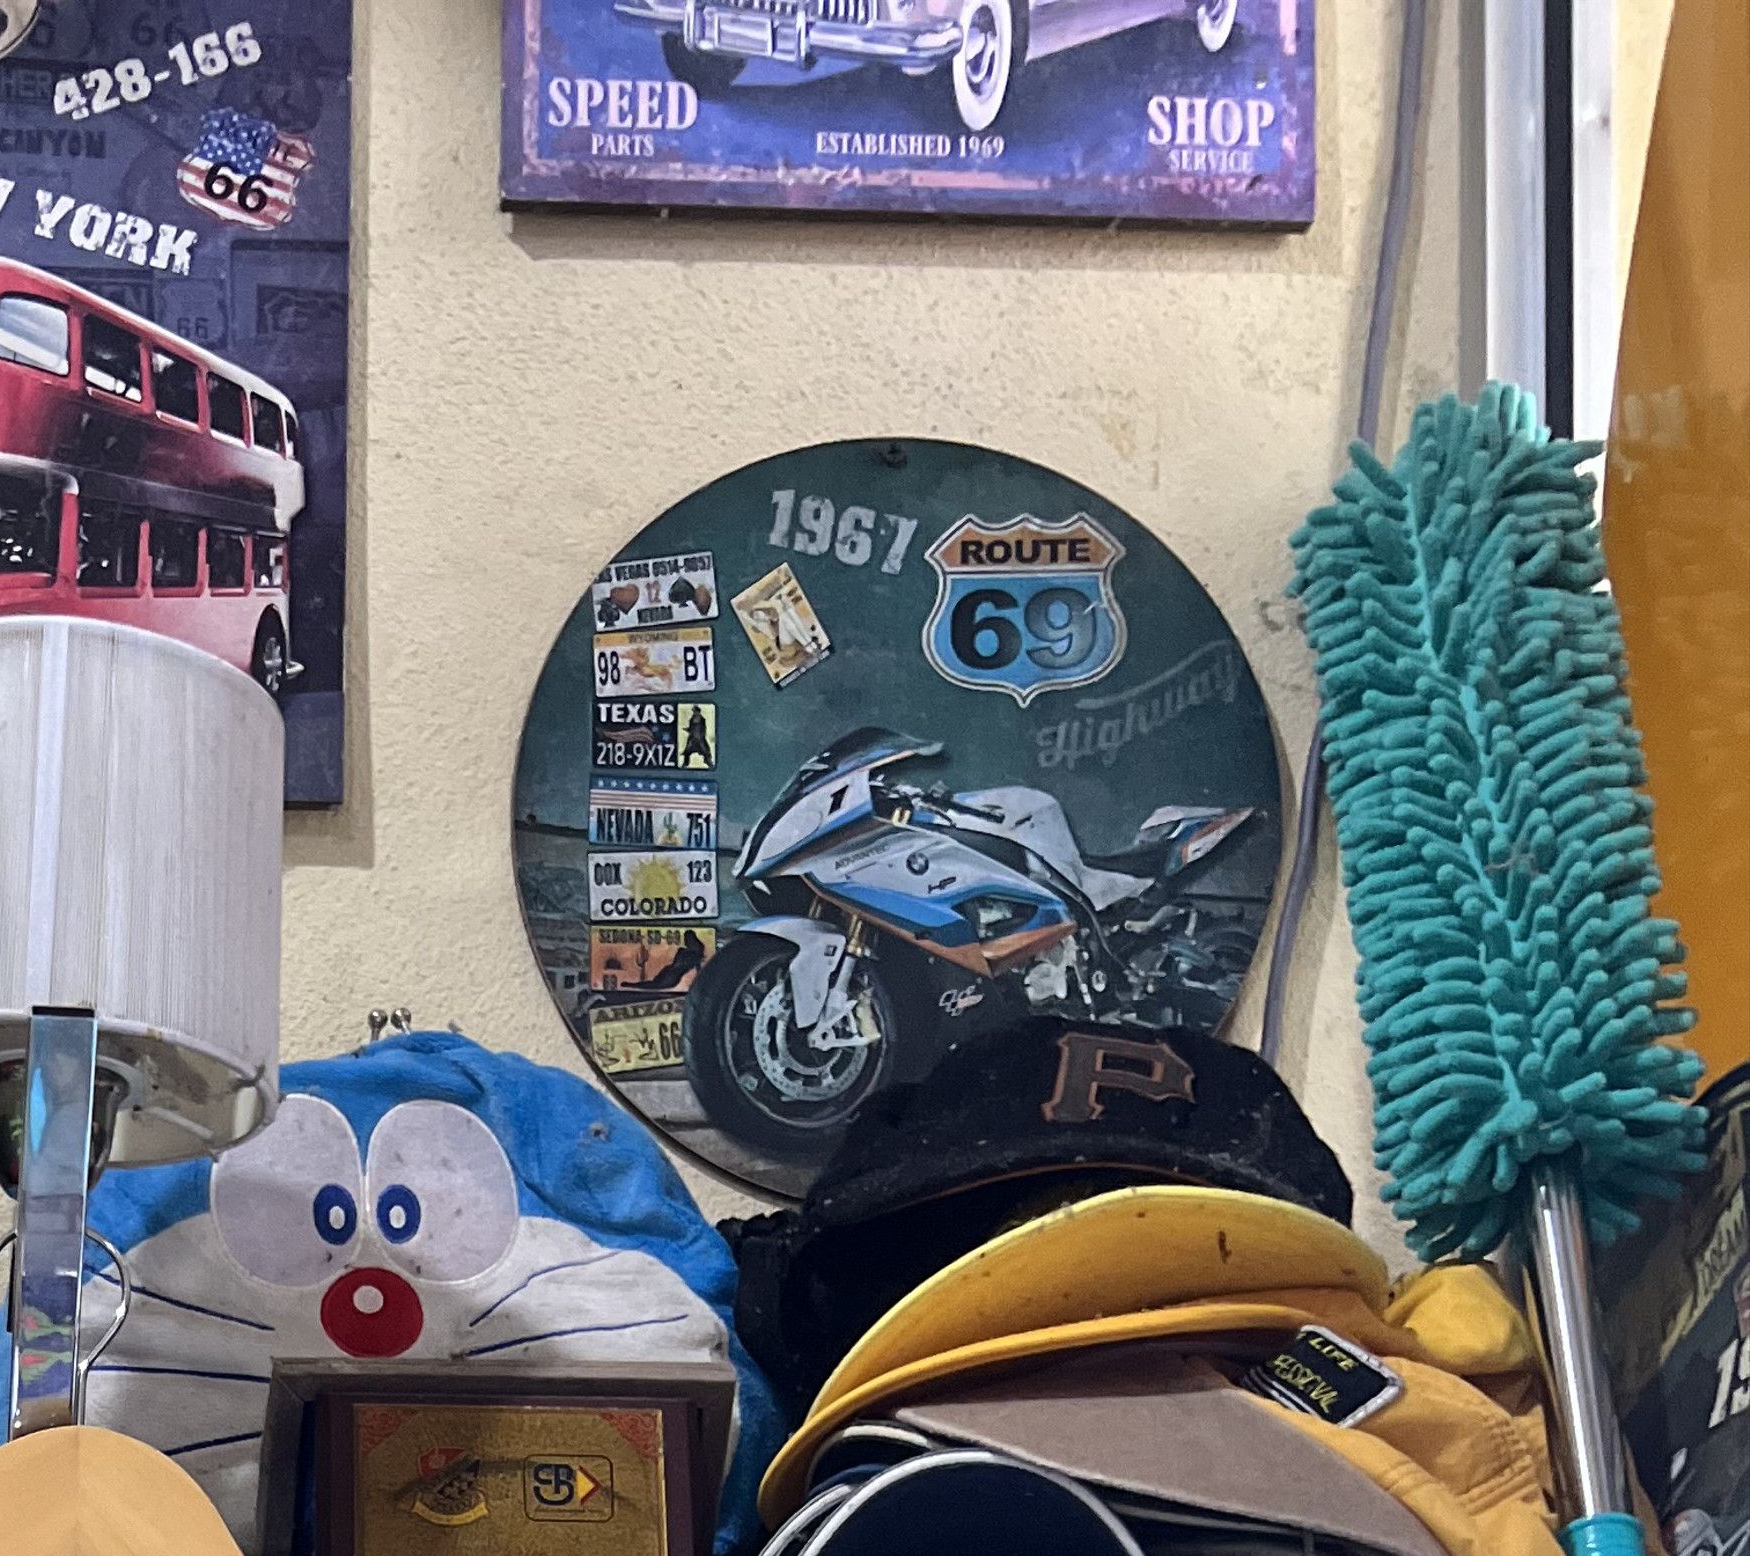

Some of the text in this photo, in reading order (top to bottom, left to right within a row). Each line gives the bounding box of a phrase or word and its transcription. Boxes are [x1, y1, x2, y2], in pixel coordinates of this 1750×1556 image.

[53, 22, 263, 120] 428-166
[548, 76, 699, 130] SPEED
[1147, 95, 1276, 149] SHOP
[591, 132, 655, 157] PARTS
[816, 131, 1005, 159] ESTABLISHED 1969
[1168, 148, 1254, 174] SERVICE
[203, 161, 274, 214] 66
[34, 189, 199, 276] YORK
[768, 489, 918, 576] 1967
[959, 536, 1091, 566] ROUTE
[949, 586, 1098, 671] 69
[598, 645, 711, 686] 98 BT
[597, 703, 675, 723] TEXAS
[1036, 650, 1239, 770] Highway
[596, 807, 712, 848] NEVADA 751
[687, 859, 713, 884] 123
[601, 895, 708, 917] COLORADO
[1041, 1032, 1196, 1124] P
